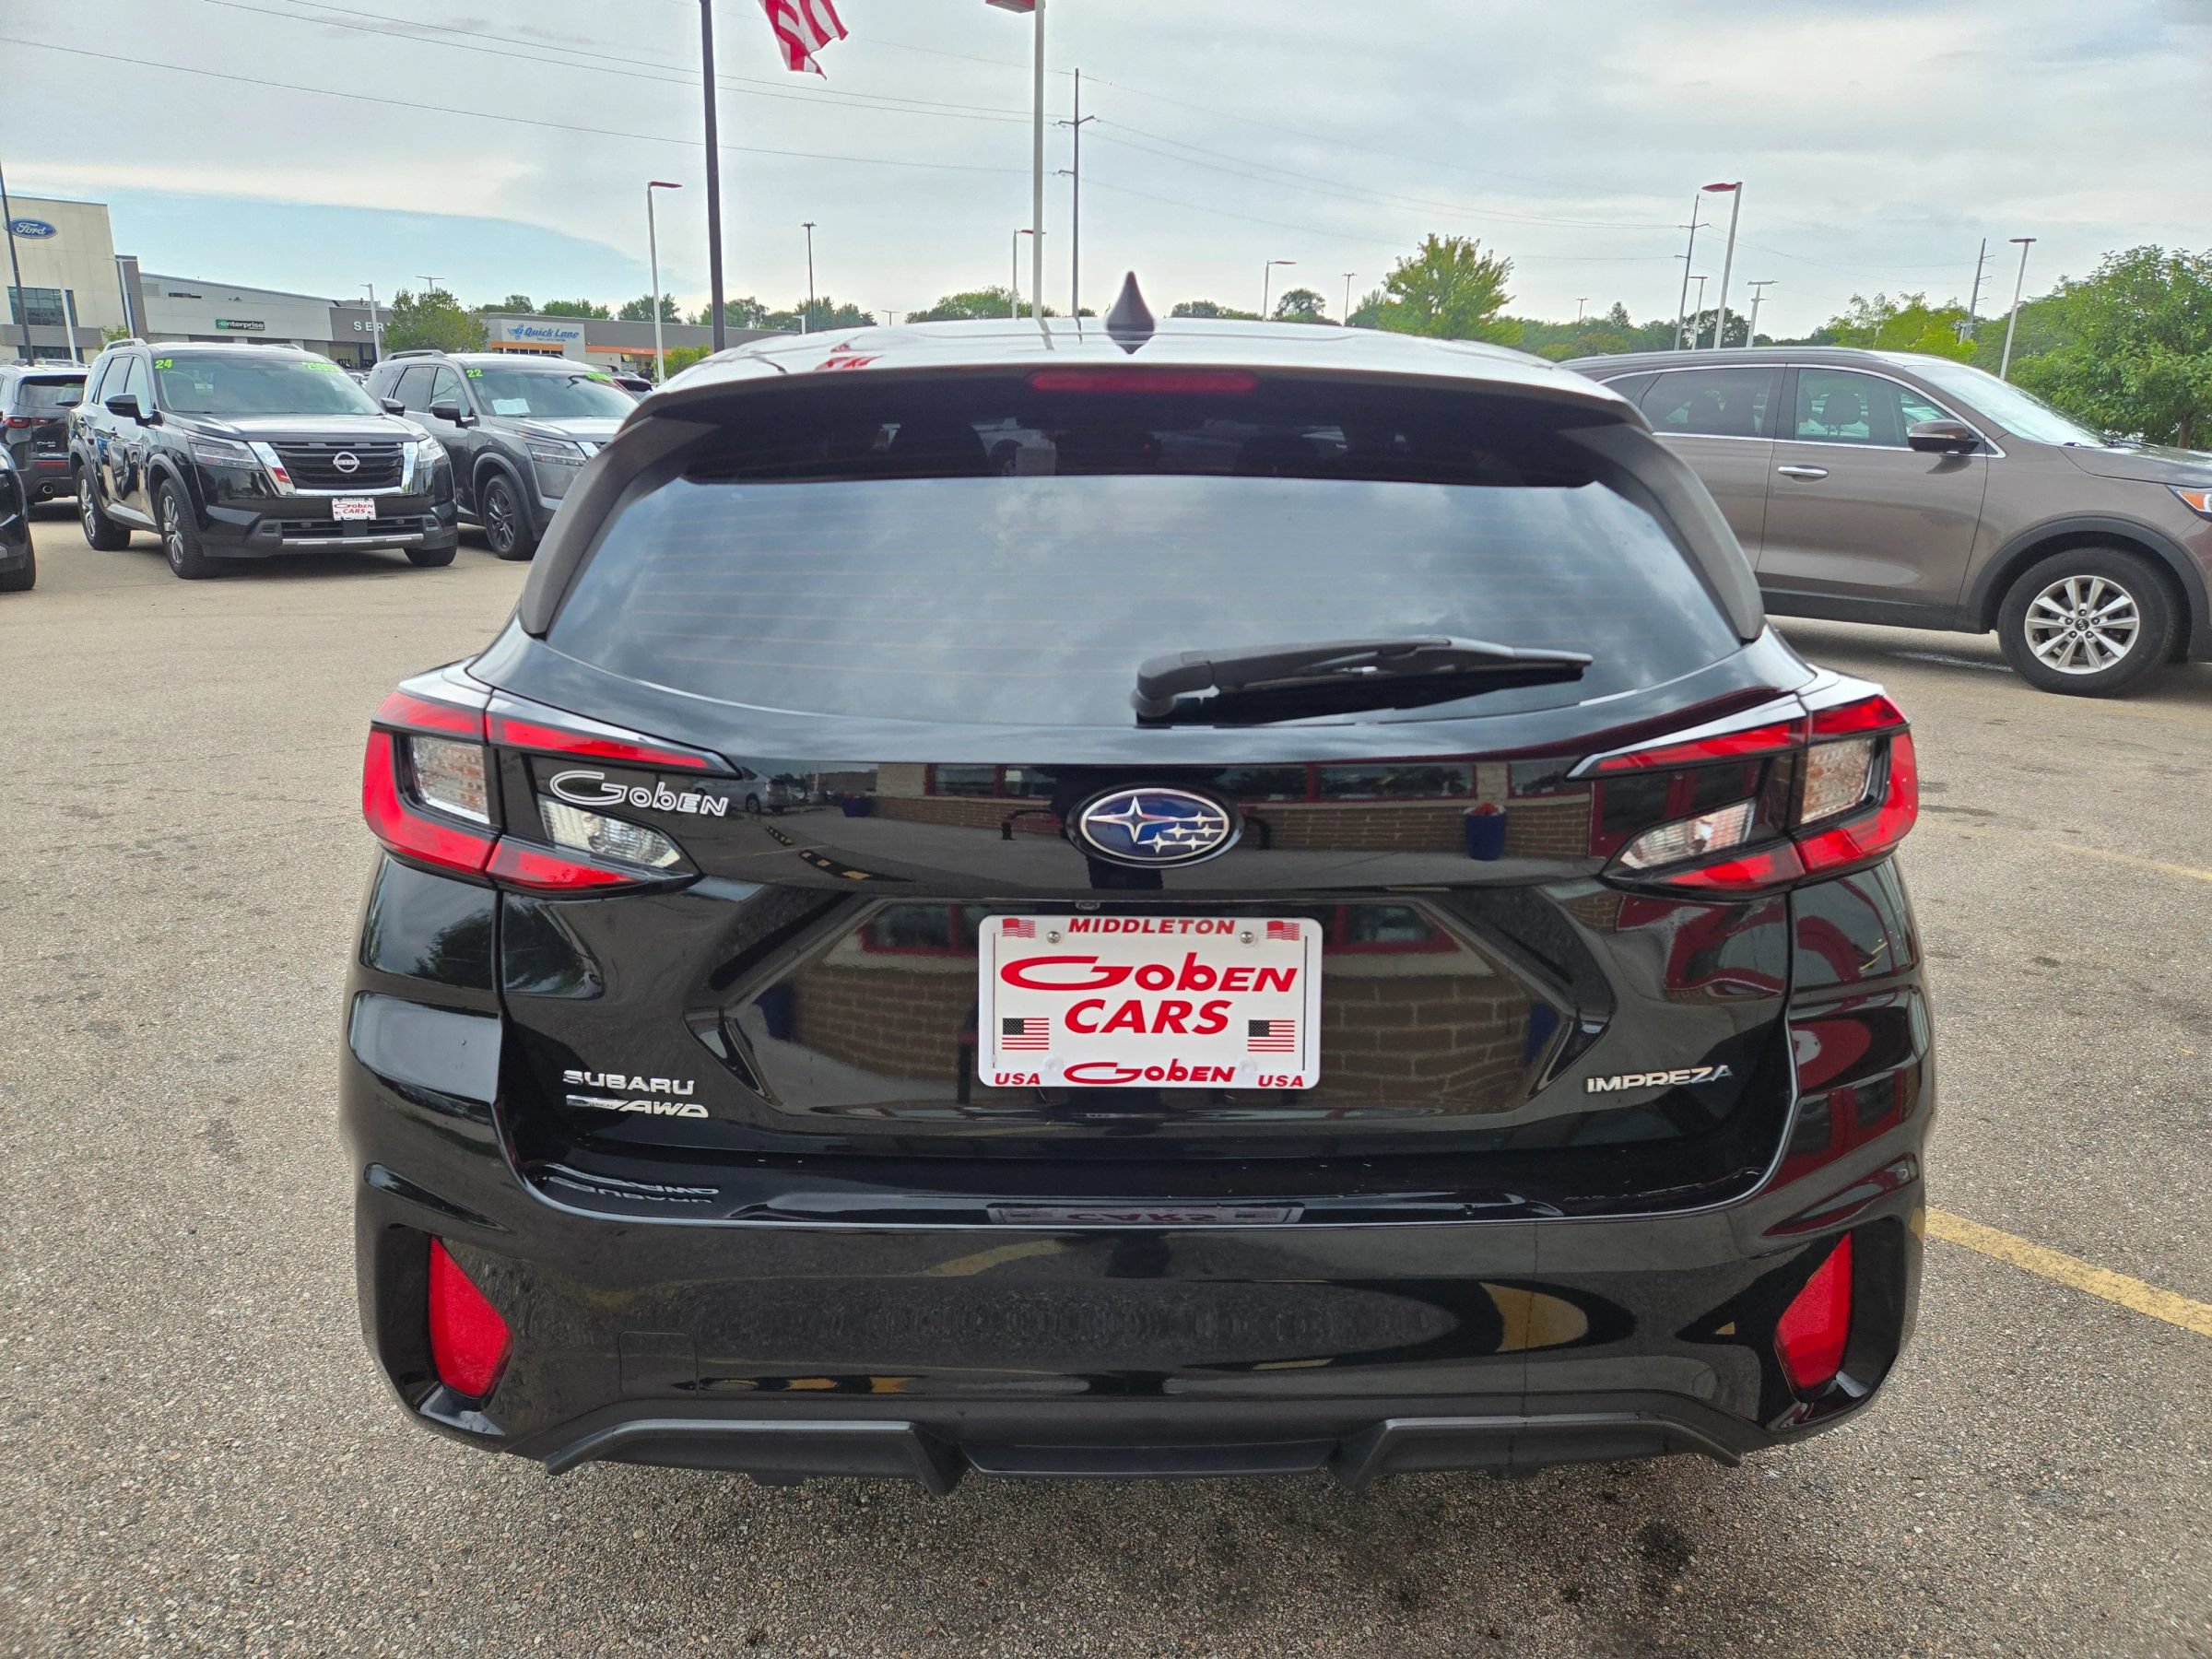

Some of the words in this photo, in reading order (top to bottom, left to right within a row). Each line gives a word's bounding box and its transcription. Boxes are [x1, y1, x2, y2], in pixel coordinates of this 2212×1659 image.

[17, 222, 46, 235] Ford
[524, 326, 553, 337] Quick
[554, 328, 580, 339] Lane
[155, 359, 172, 369] 24
[466, 370, 483, 378] 22
[1067, 918, 1236, 935] MIDDLETON
[1065, 998, 1233, 1035] CARS
[562, 1069, 694, 1095] SUBARU
[994, 1072, 1041, 1086] USA
[1257, 1075, 1304, 1088] USA
[1586, 1065, 1733, 1093] IMPREZA
[618, 1100, 709, 1118] AWD
